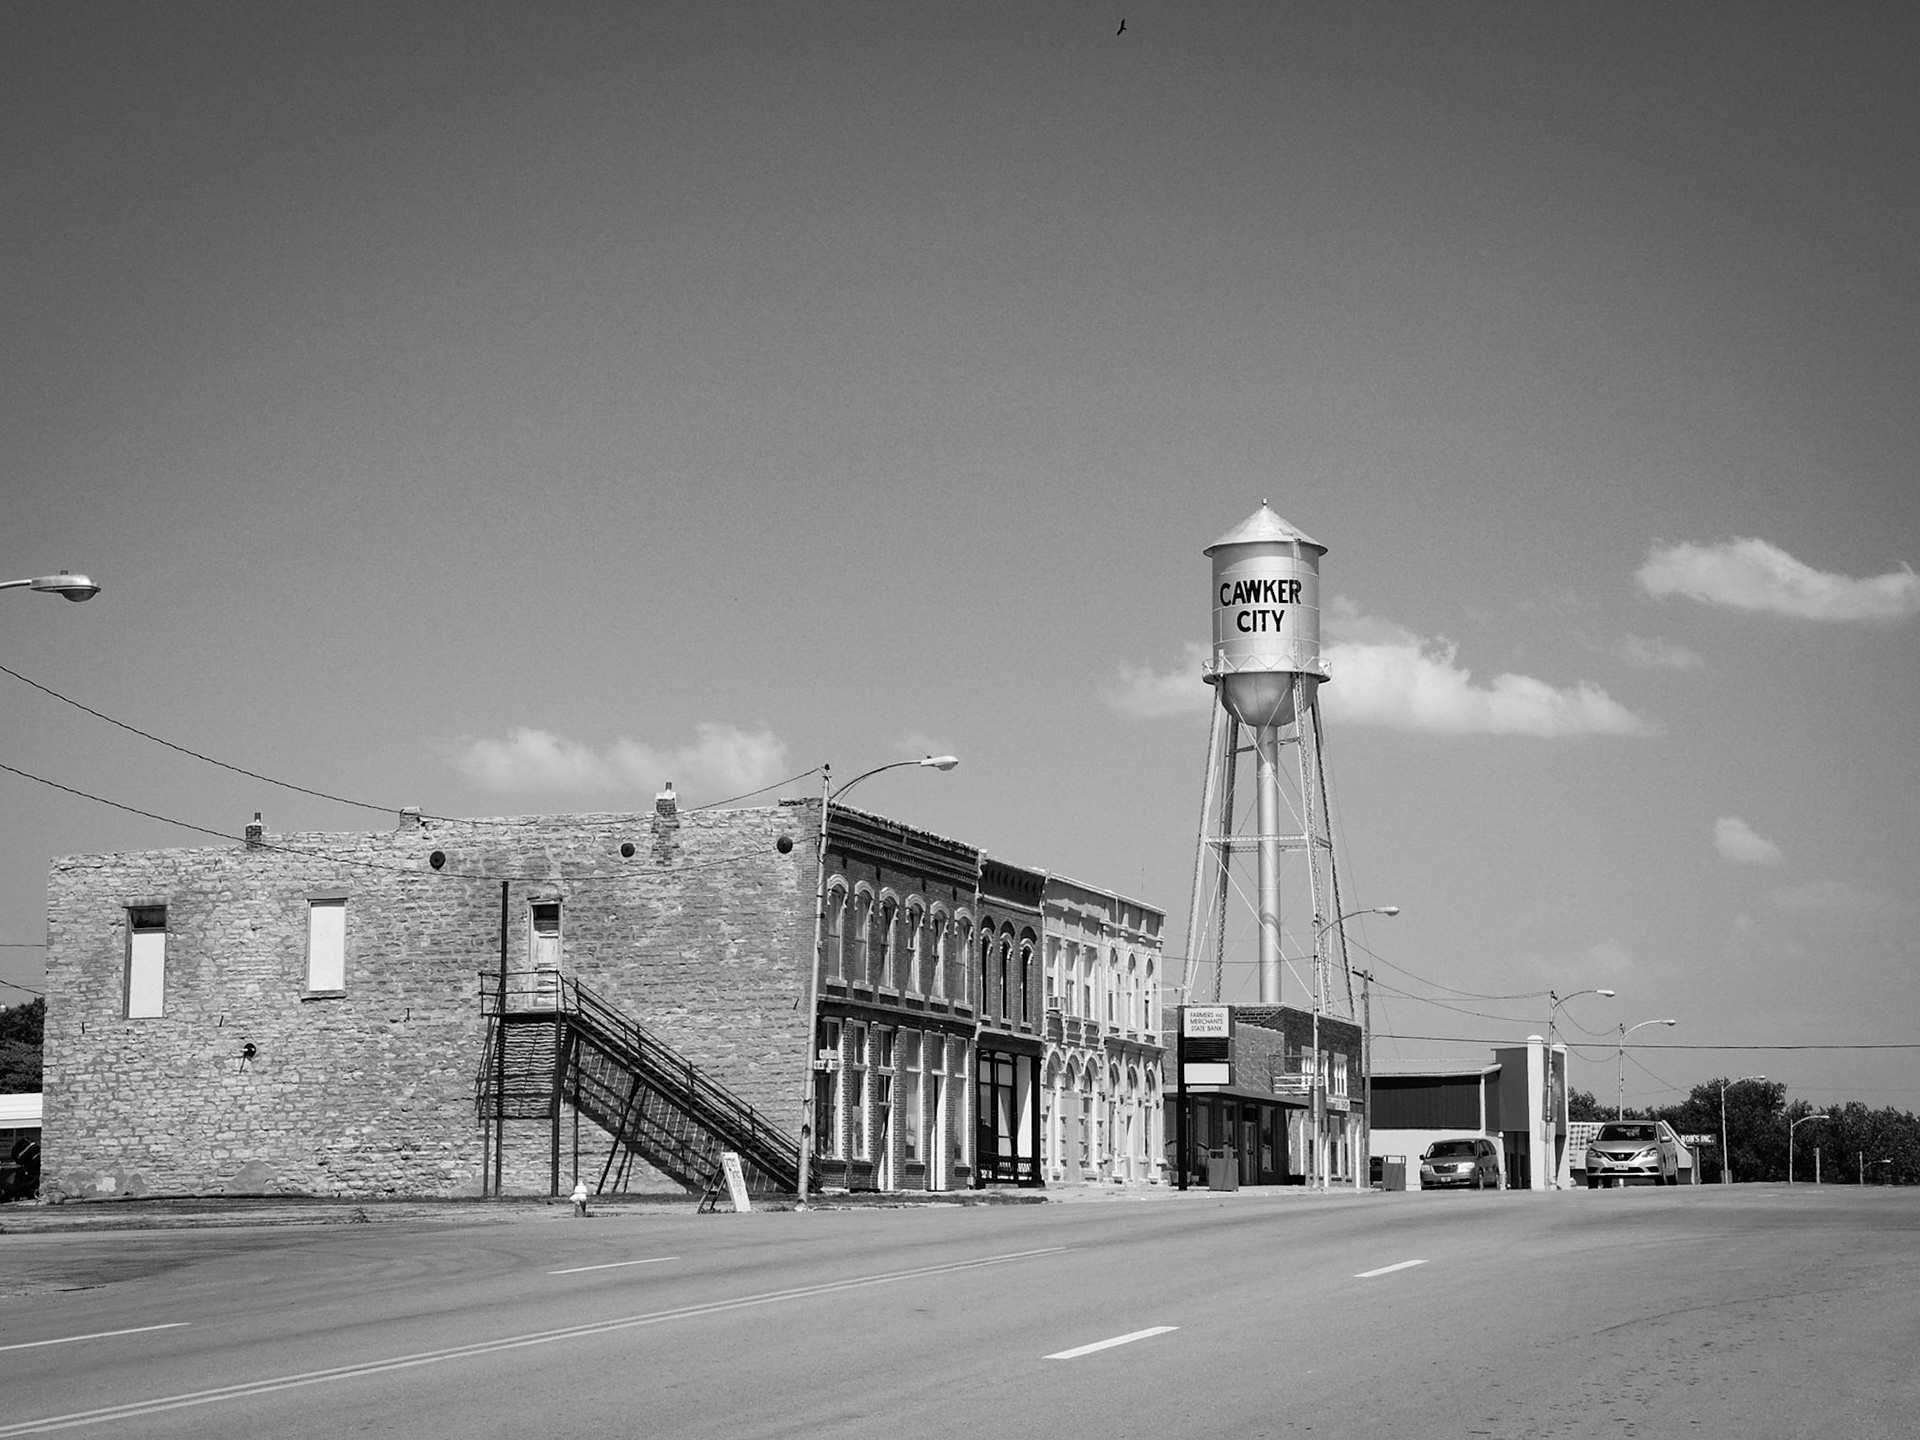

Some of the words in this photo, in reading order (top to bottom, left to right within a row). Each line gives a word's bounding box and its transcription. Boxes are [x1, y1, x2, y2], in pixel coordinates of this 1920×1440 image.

[1220, 579, 1302, 606] CAWKER
[1237, 610, 1285, 632] CITY
[1681, 1134, 1700, 1143] BOB'S
[1701, 1134, 1715, 1143] INC.
